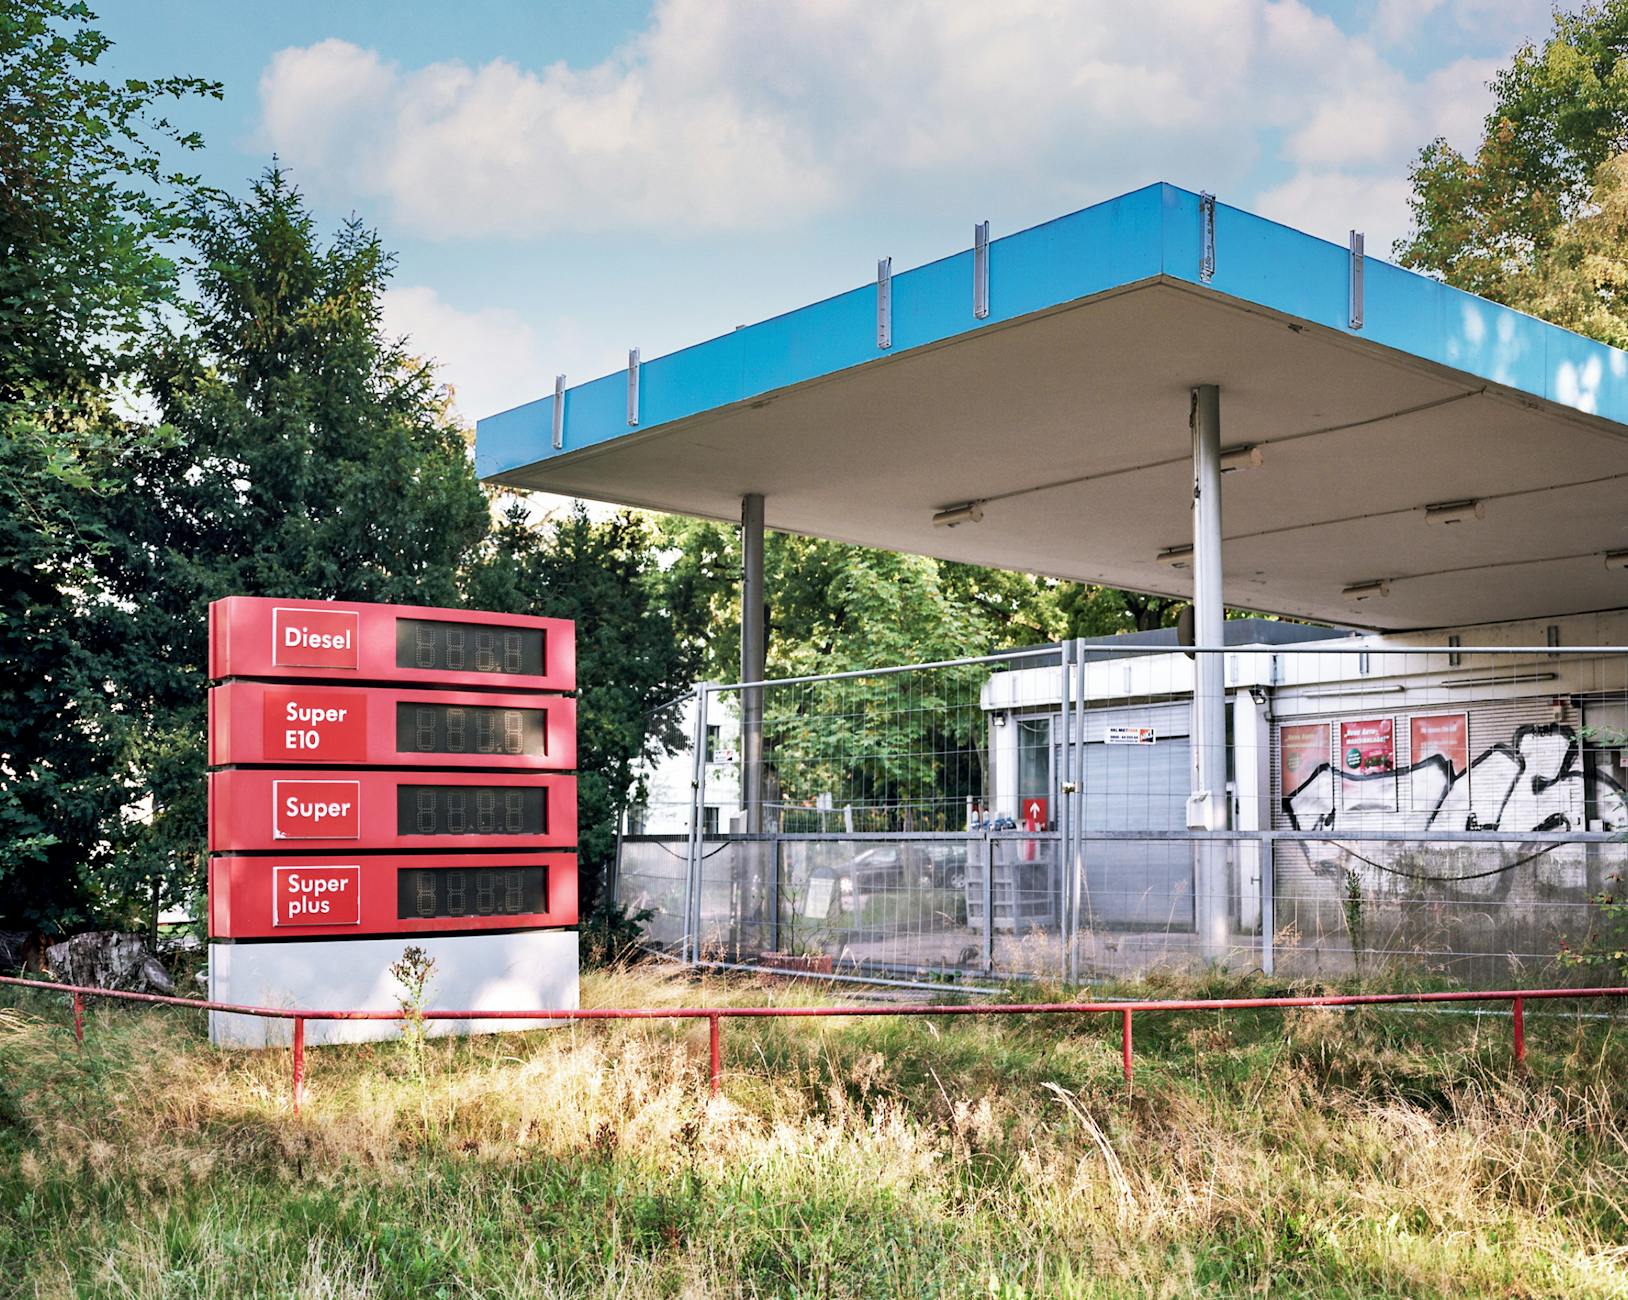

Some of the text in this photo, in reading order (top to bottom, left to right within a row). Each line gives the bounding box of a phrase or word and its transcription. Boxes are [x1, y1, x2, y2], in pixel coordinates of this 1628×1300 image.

[286, 627, 351, 649] Diesel
[286, 702, 347, 725] Super
[286, 730, 320, 749] E10
[286, 797, 351, 821] Super
[288, 874, 349, 896] Super
[288, 895, 330, 918] plus
